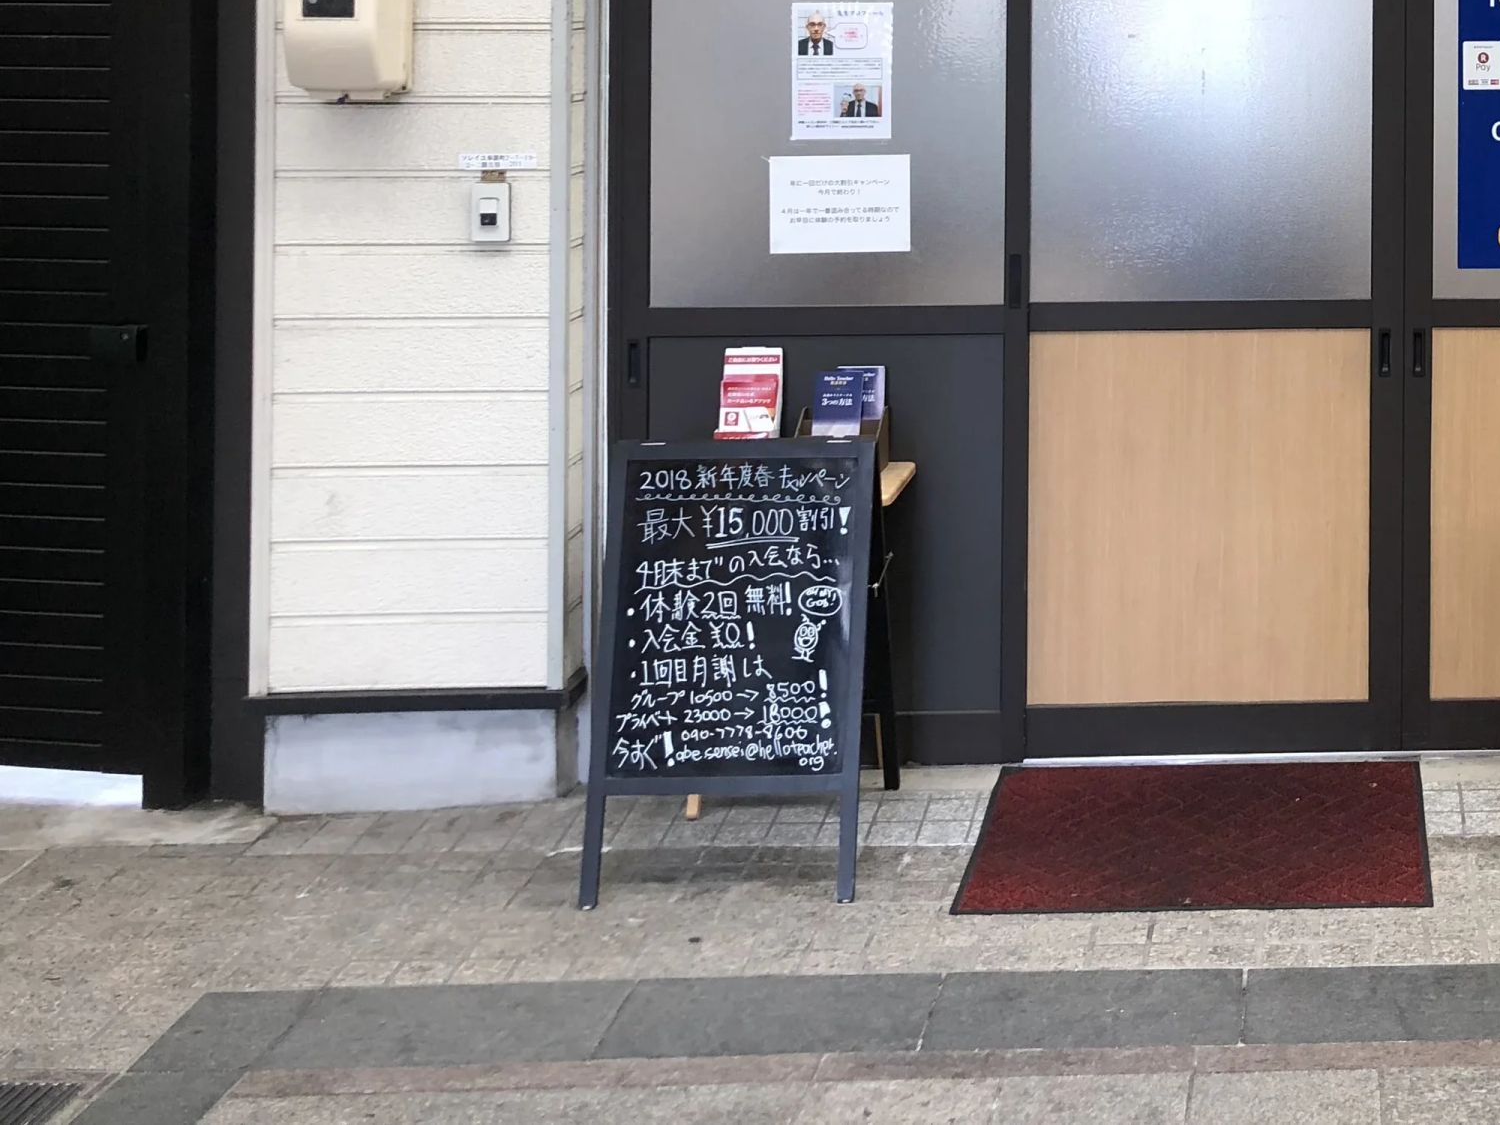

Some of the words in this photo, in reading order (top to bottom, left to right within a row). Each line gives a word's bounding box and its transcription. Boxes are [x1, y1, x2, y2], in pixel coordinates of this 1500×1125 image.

[1475, 63, 1490, 72] Pay
[689, 690, 733, 706] 10500
[683, 708, 731, 724] 23000
[799, 755, 825, 772] org
